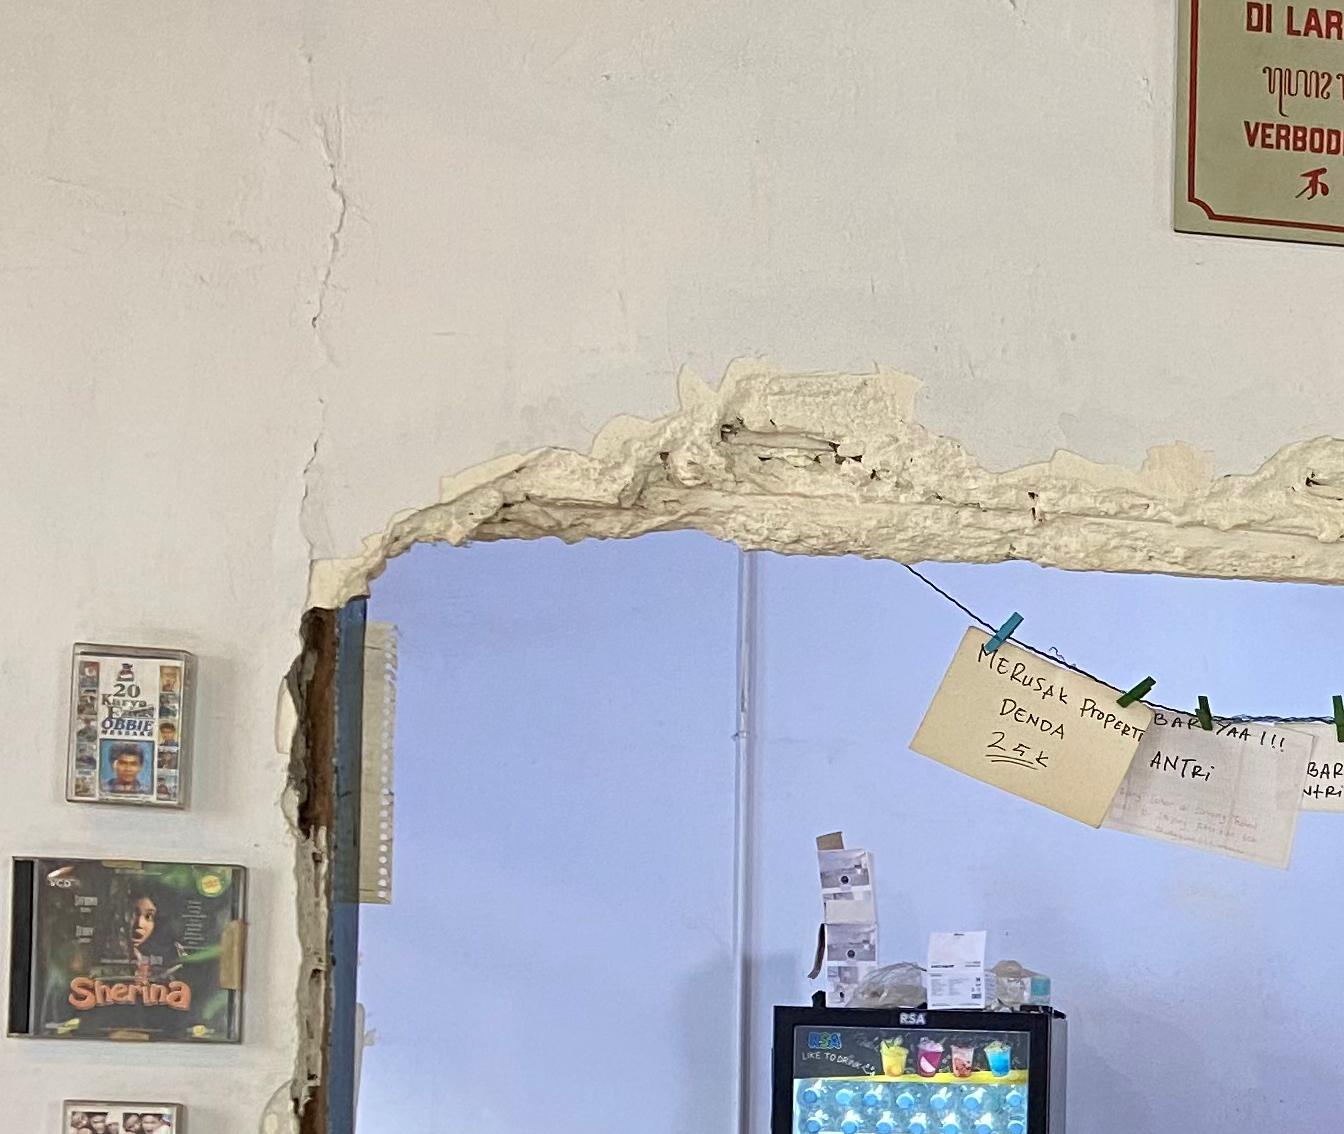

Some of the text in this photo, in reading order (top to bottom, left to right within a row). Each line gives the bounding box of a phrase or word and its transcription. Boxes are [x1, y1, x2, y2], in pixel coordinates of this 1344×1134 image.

[1246, 1, 1272, 33] DI
[112, 683, 141, 699] 20
[101, 718, 155, 732] OBBIE
[1000, 697, 1066, 741] DENDA
[1306, 761, 1344, 780] BAR
[68, 973, 192, 1011] Sherina
[900, 1012, 926, 1026] RSA
